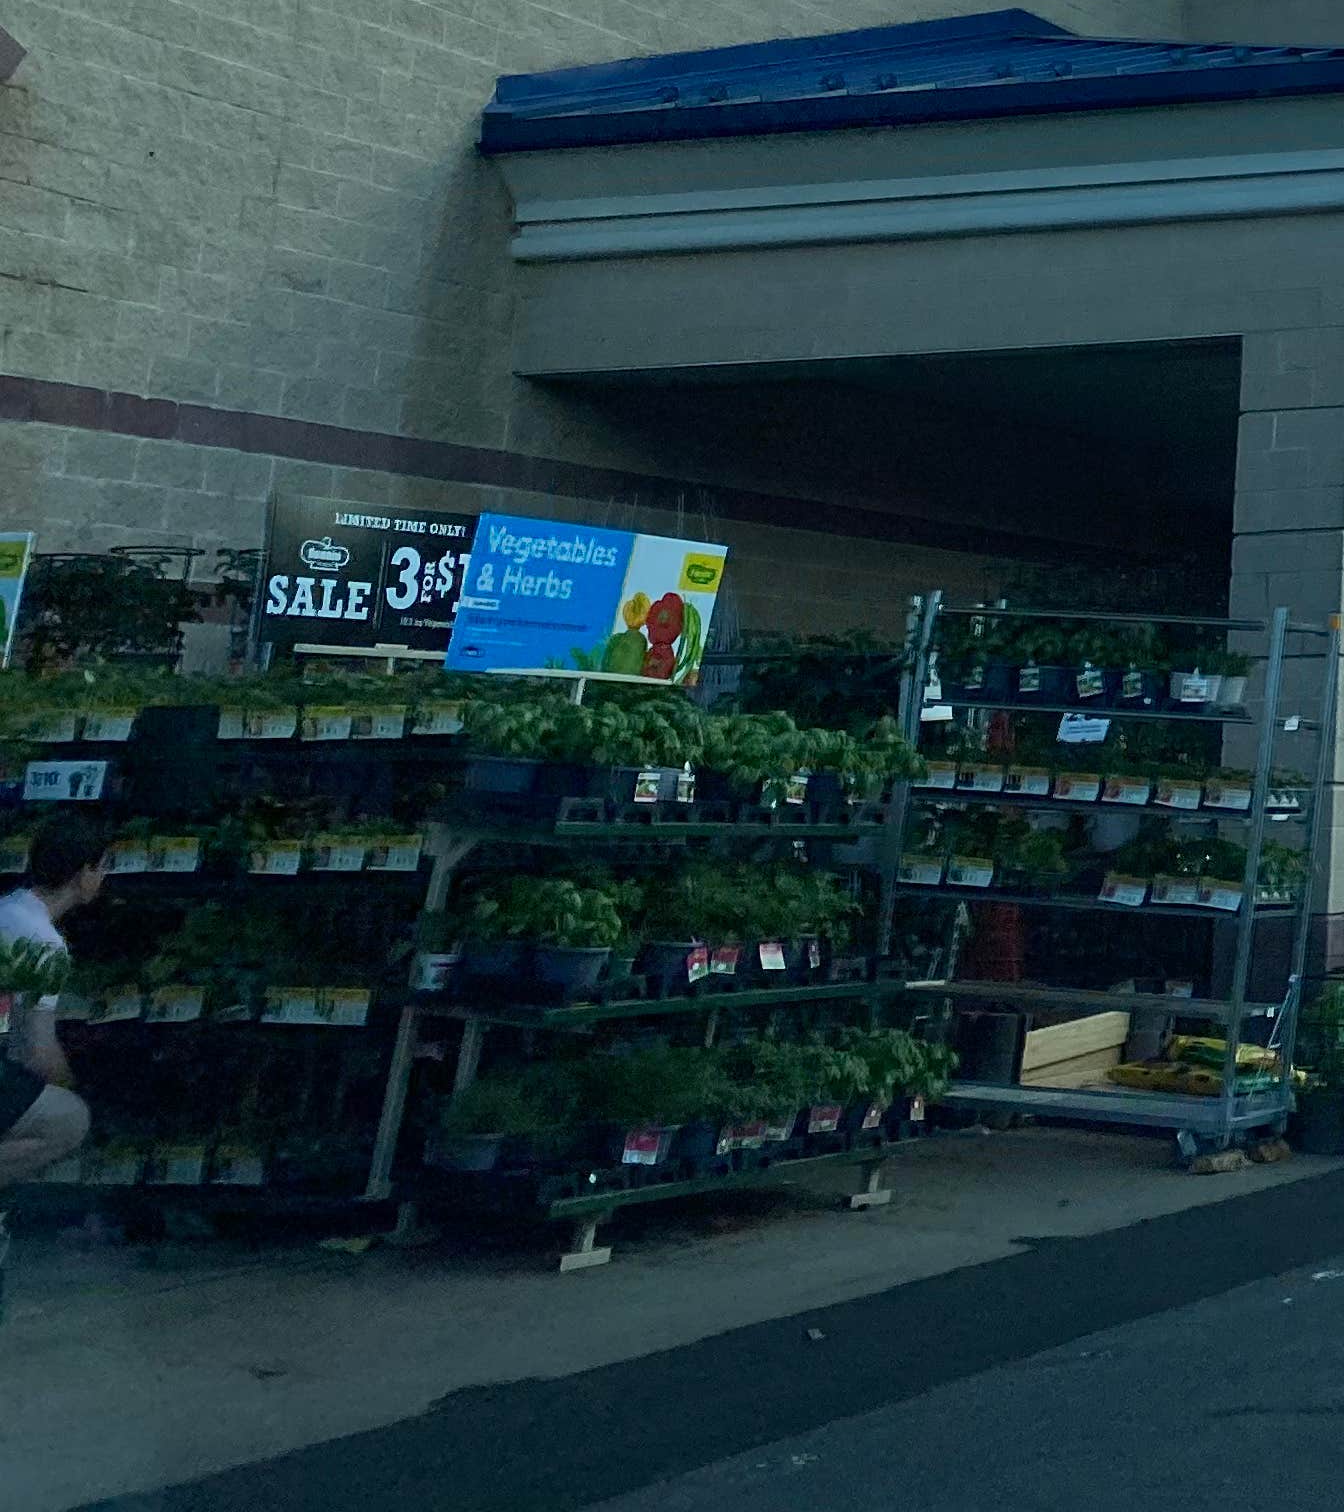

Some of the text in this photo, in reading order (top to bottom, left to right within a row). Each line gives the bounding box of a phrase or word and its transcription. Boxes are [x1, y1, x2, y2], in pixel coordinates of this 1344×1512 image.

[335, 512, 467, 537] LIMITED TIME ONLY!
[489, 525, 618, 567] Vegetables
[266, 575, 372, 620] SALE
[386, 546, 421, 610] 3
[420, 561, 438, 603] FOR
[476, 563, 574, 600] & Herbs
